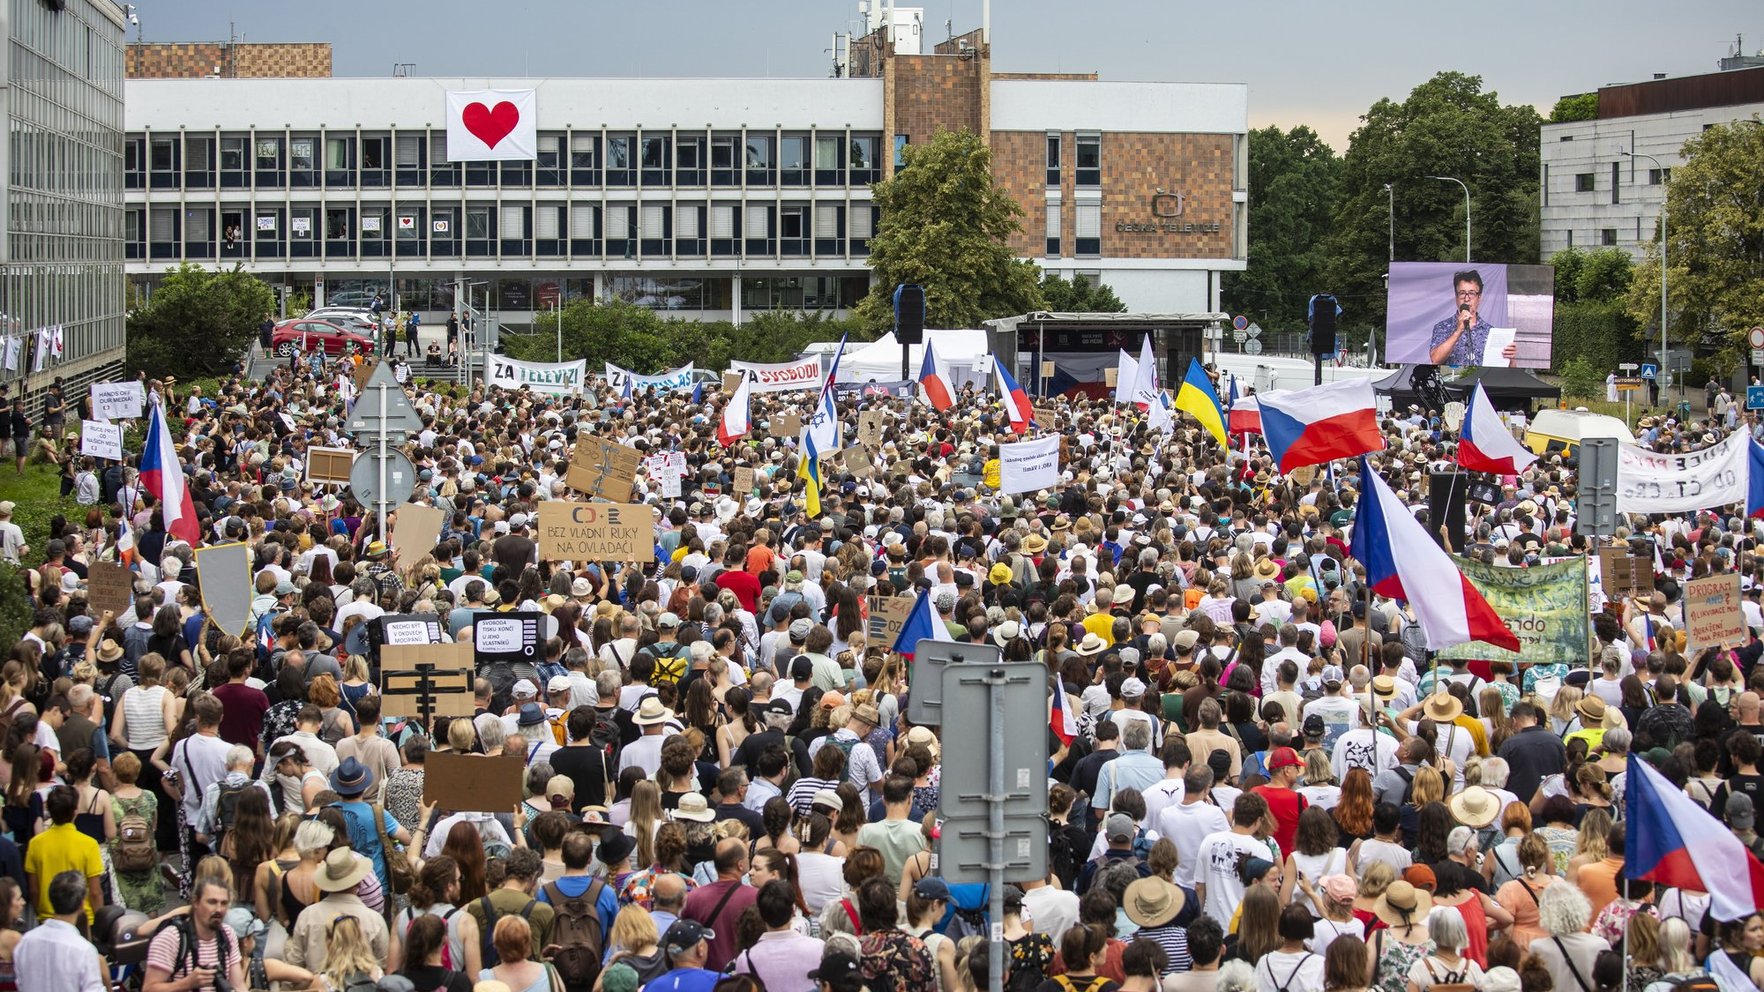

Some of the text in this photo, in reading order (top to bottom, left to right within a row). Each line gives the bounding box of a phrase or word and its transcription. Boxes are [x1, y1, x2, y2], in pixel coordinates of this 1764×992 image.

[1163, 223, 1220, 233] TELEVIZE
[495, 363, 579, 384] ZA TELEVIZI
[760, 363, 819, 383] SVOBODU
[548, 525, 638, 539] BEZ VLÁDNÍ RUKY
[557, 540, 634, 554] NA OVLADAČI
[1689, 582, 1731, 598] PROGRAM
[870, 598, 889, 613] NE
